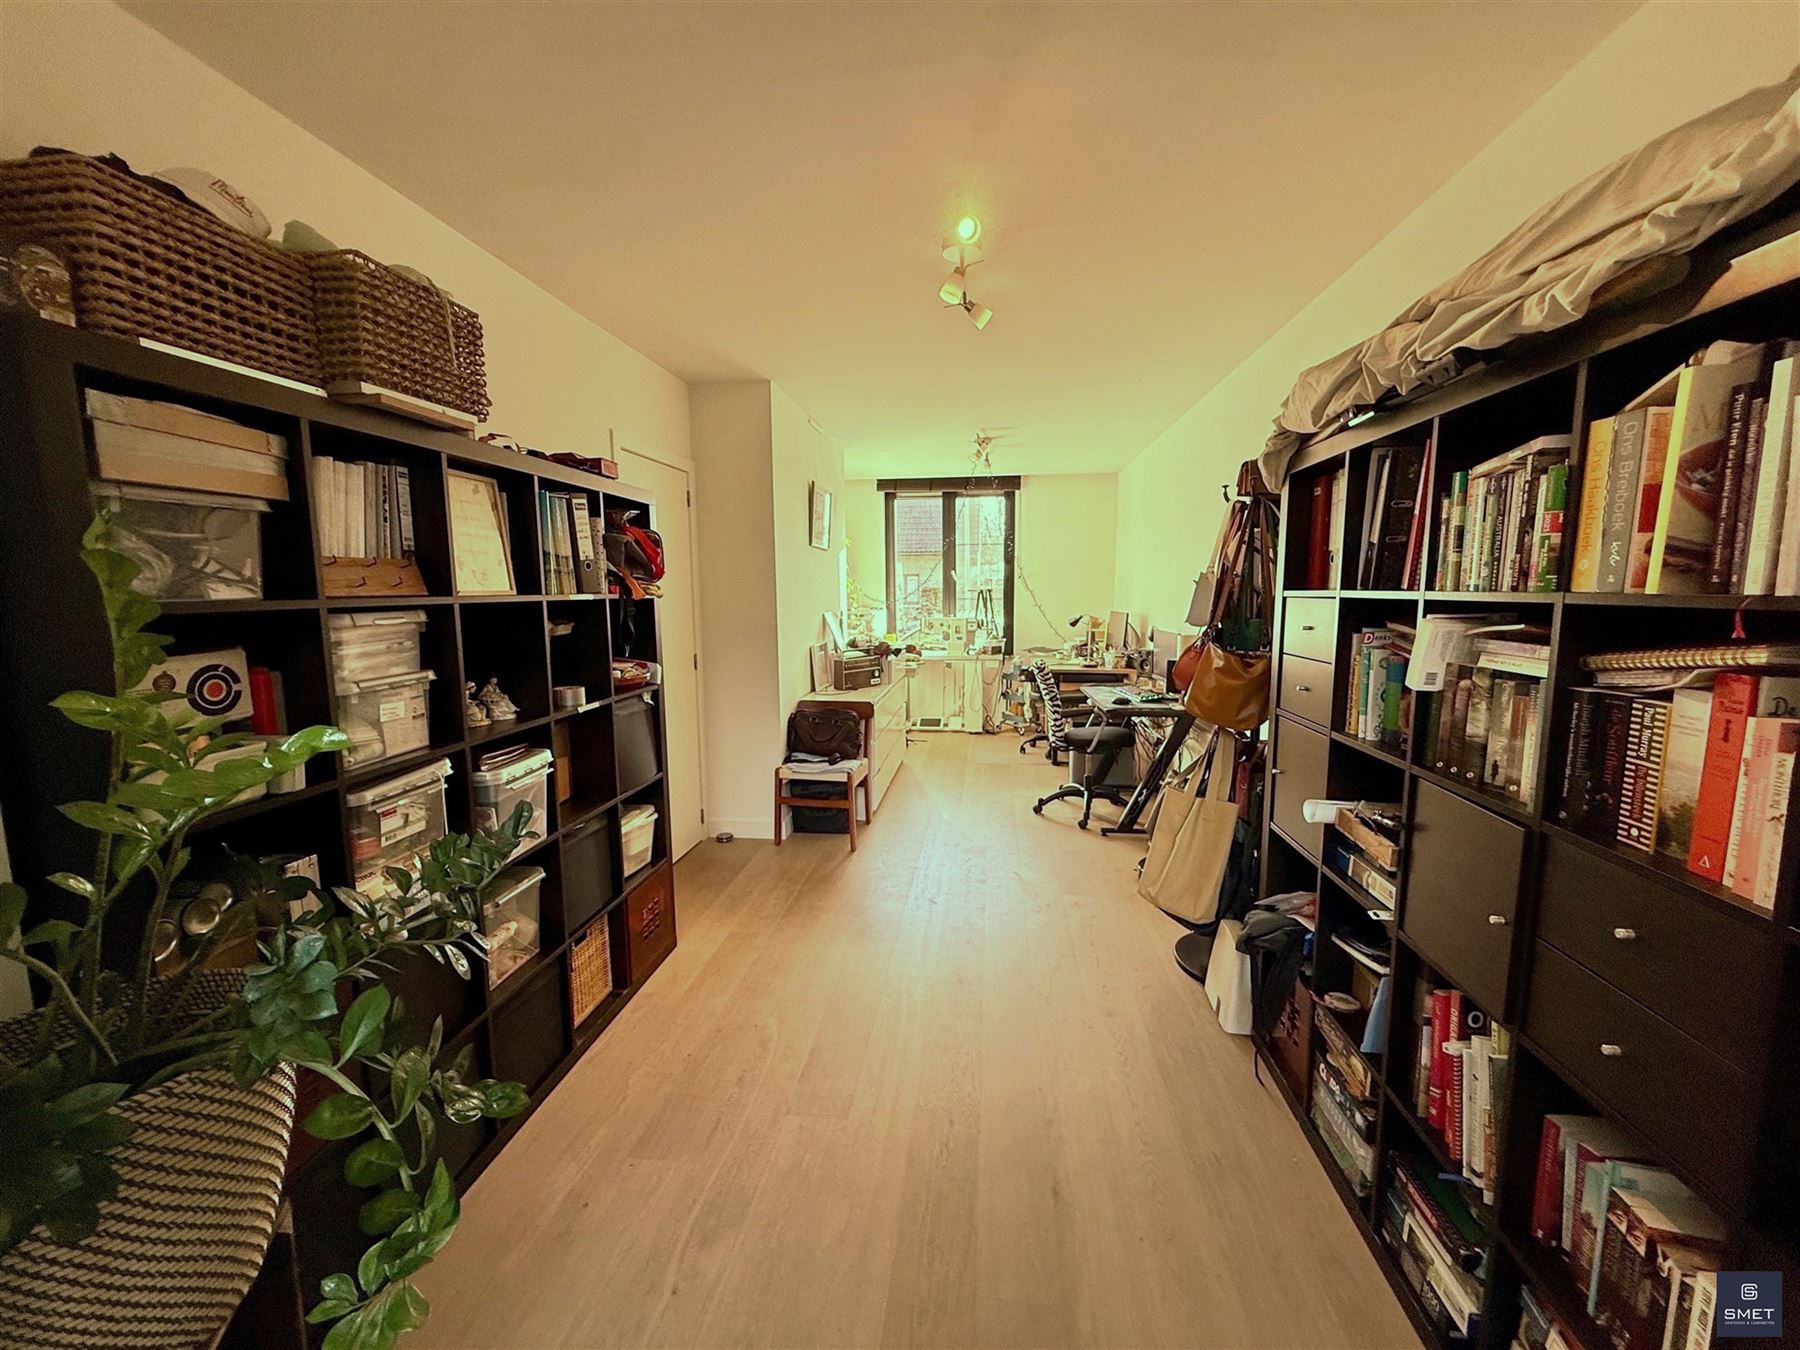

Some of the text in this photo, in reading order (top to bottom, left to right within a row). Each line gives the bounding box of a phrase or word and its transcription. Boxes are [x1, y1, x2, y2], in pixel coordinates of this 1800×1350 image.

[1620, 420, 1639, 456] Ons
[1581, 440, 1607, 553] Ons Haakboek
[1611, 459, 1634, 532] Breiboek
[1493, 515, 1503, 558] AUSTRALIA
[1643, 706, 1655, 727] Paul
[1637, 728, 1653, 758] Murray
[1449, 1008, 1459, 1043] ORIGAM
